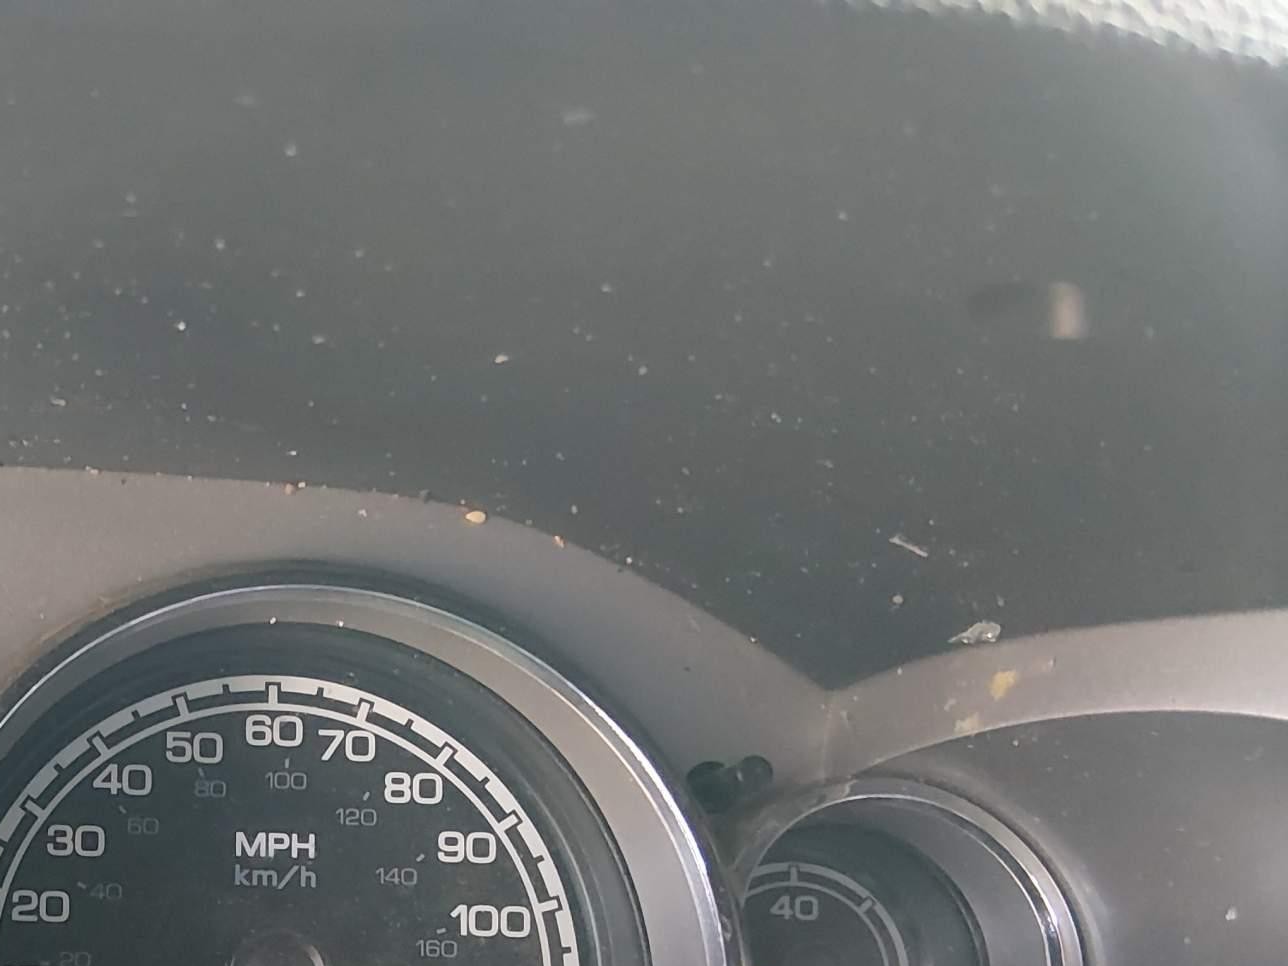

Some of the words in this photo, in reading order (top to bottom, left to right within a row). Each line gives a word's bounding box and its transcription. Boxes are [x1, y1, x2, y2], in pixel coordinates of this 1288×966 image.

[245, 715, 303, 748] 60
[165, 732, 224, 764] 50
[318, 729, 376, 763] 70
[93, 763, 153, 797] 40
[195, 780, 227, 799] 80
[265, 772, 308, 791] 100
[384, 772, 443, 805] 80
[127, 817, 160, 836] 60
[335, 808, 378, 827] 120
[47, 825, 106, 857] 30
[234, 831, 316, 859] MPH
[437, 831, 497, 864] 90
[234, 865, 318, 889] km/h
[376, 867, 418, 886] 140
[91, 882, 123, 900] 40
[12, 890, 70, 923] 20
[769, 895, 819, 920] 40
[450, 905, 531, 938] 100
[416, 940, 458, 959] 160
